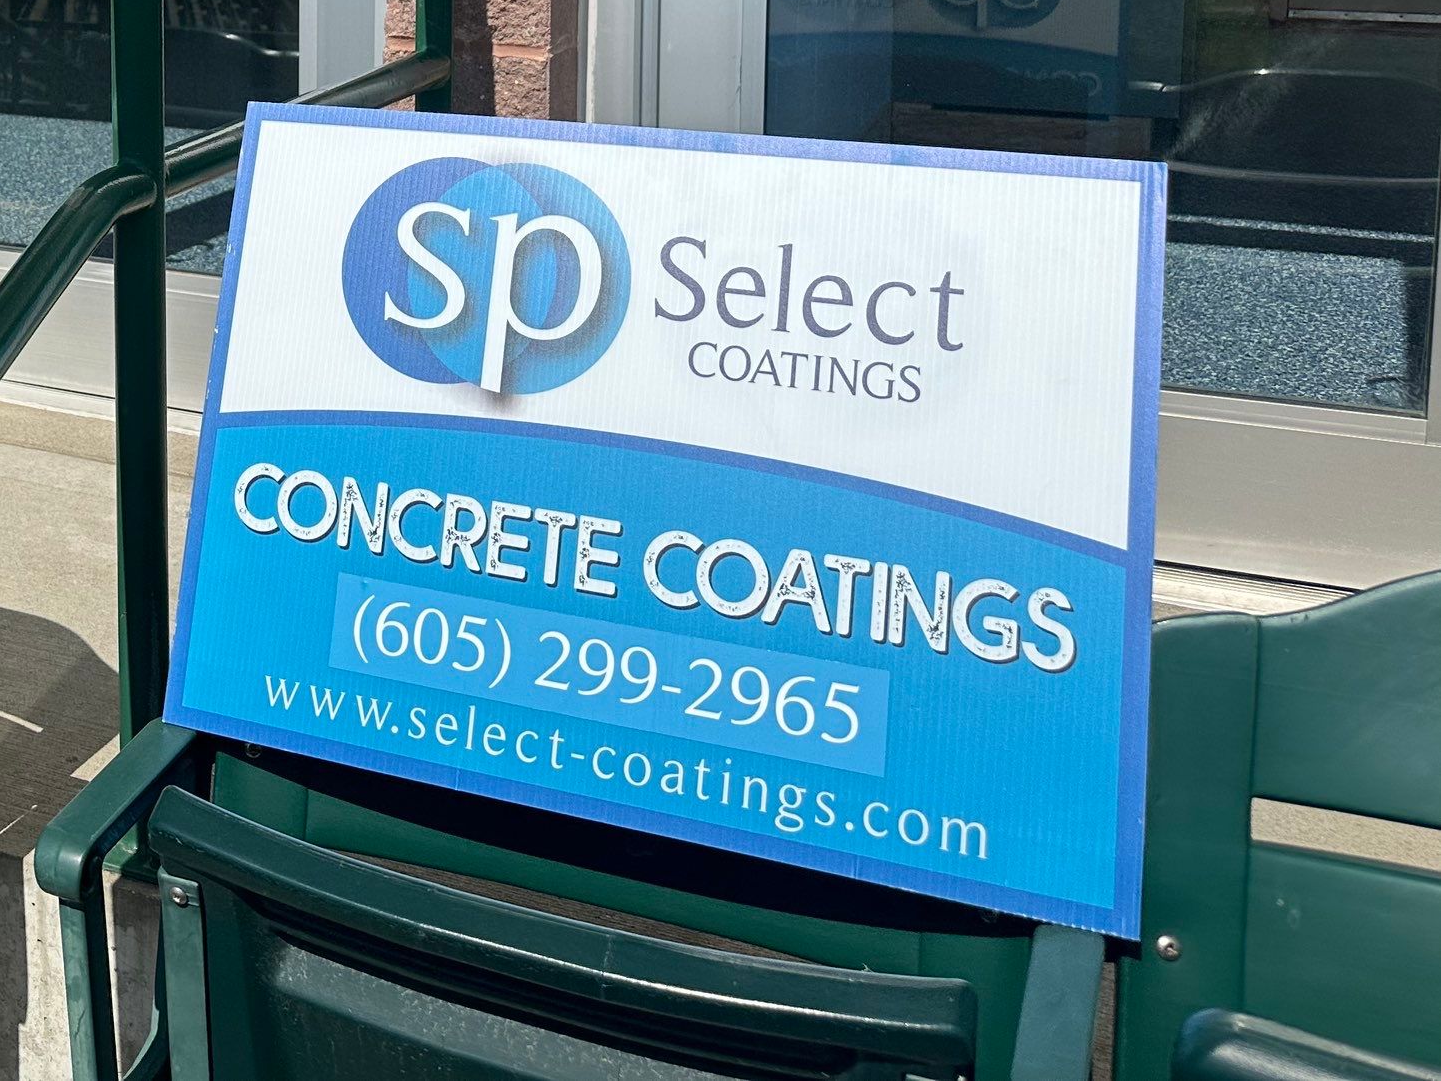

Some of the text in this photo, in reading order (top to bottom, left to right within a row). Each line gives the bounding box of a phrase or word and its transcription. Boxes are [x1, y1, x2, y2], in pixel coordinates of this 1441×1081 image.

[384, 200, 603, 394] sp
[654, 235, 965, 352] Select
[687, 340, 923, 403] COATINGS
[233, 462, 1077, 674] CONCRETE COATINGS
[353, 594, 860, 745] (605) 299-2965
[264, 674, 990, 860] www.select-coatings.com
